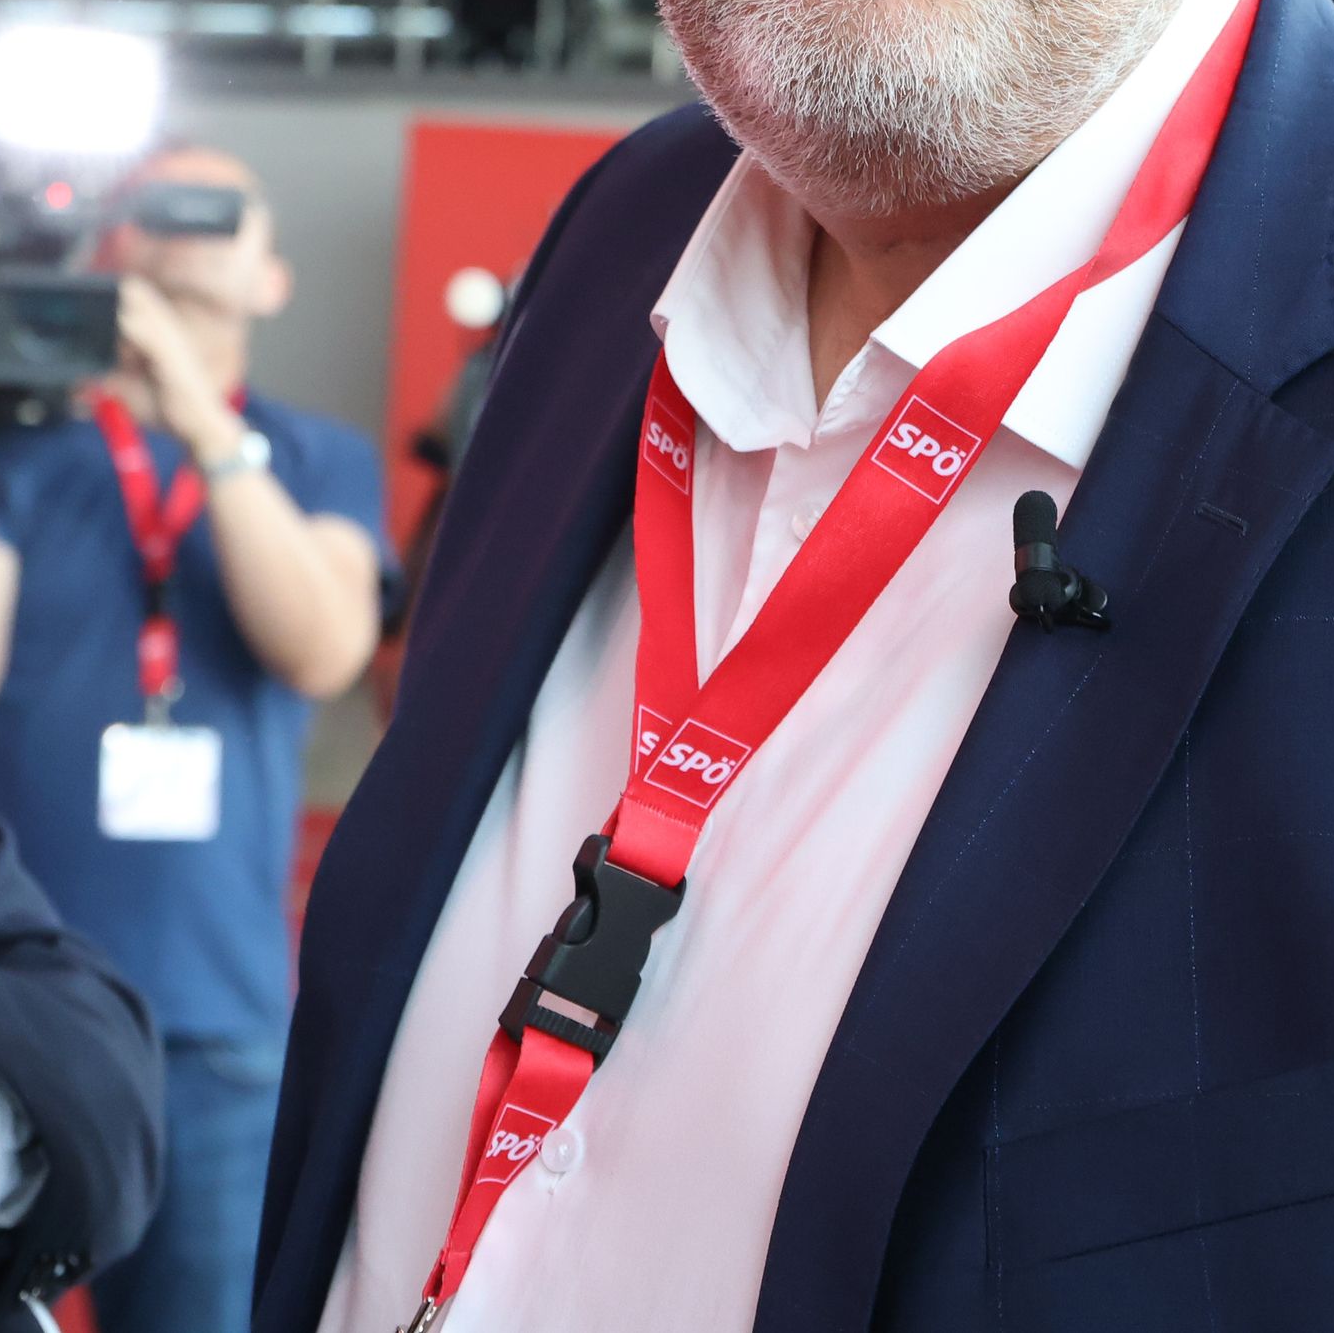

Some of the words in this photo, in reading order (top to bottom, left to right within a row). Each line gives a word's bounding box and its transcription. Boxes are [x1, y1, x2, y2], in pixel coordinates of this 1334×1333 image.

[647, 422, 688, 471] SPÖ
[887, 422, 967, 477] SPÖ
[660, 743, 736, 785] SPÖ
[486, 1130, 541, 1161] SPÖ
